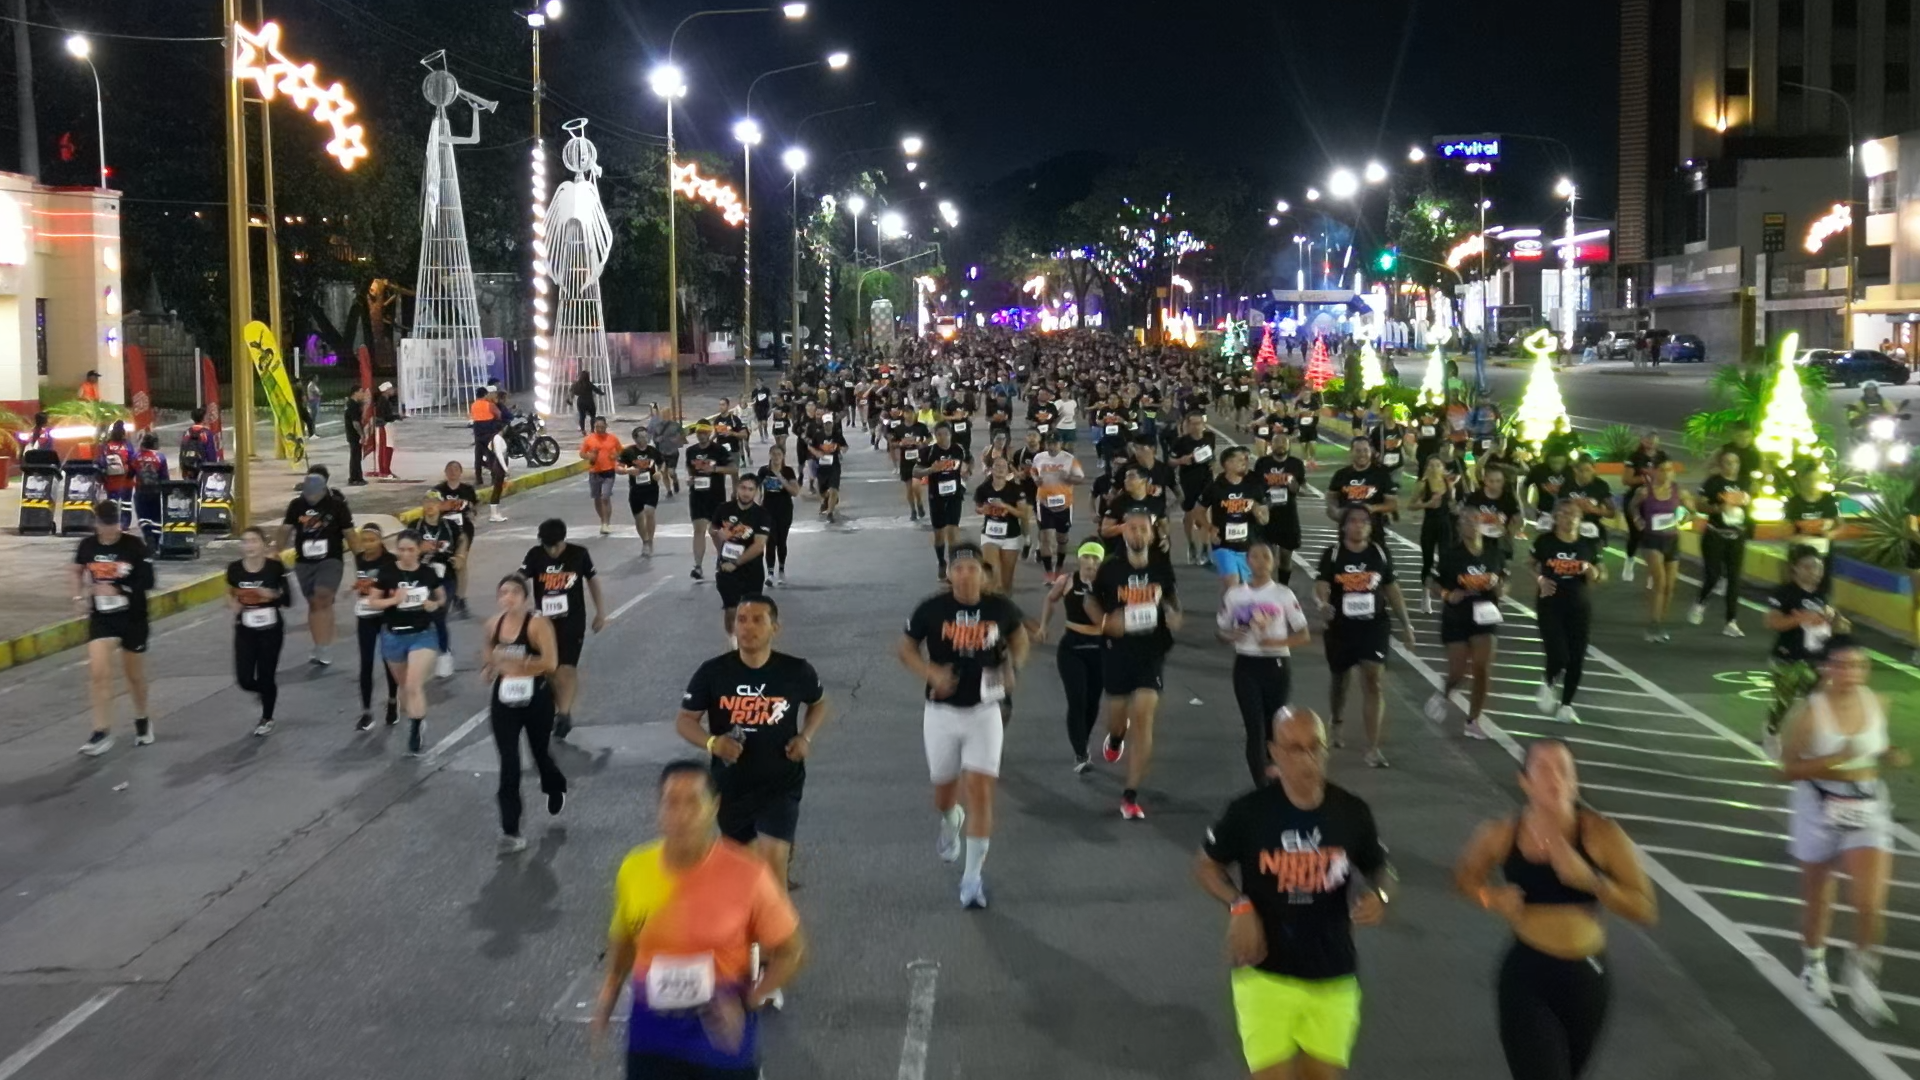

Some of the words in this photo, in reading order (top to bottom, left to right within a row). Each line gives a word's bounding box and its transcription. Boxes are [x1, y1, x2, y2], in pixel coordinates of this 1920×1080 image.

[736, 684, 767, 700] CLX
[719, 695, 786, 710] NIGHT
[730, 710, 778, 725] RUN
